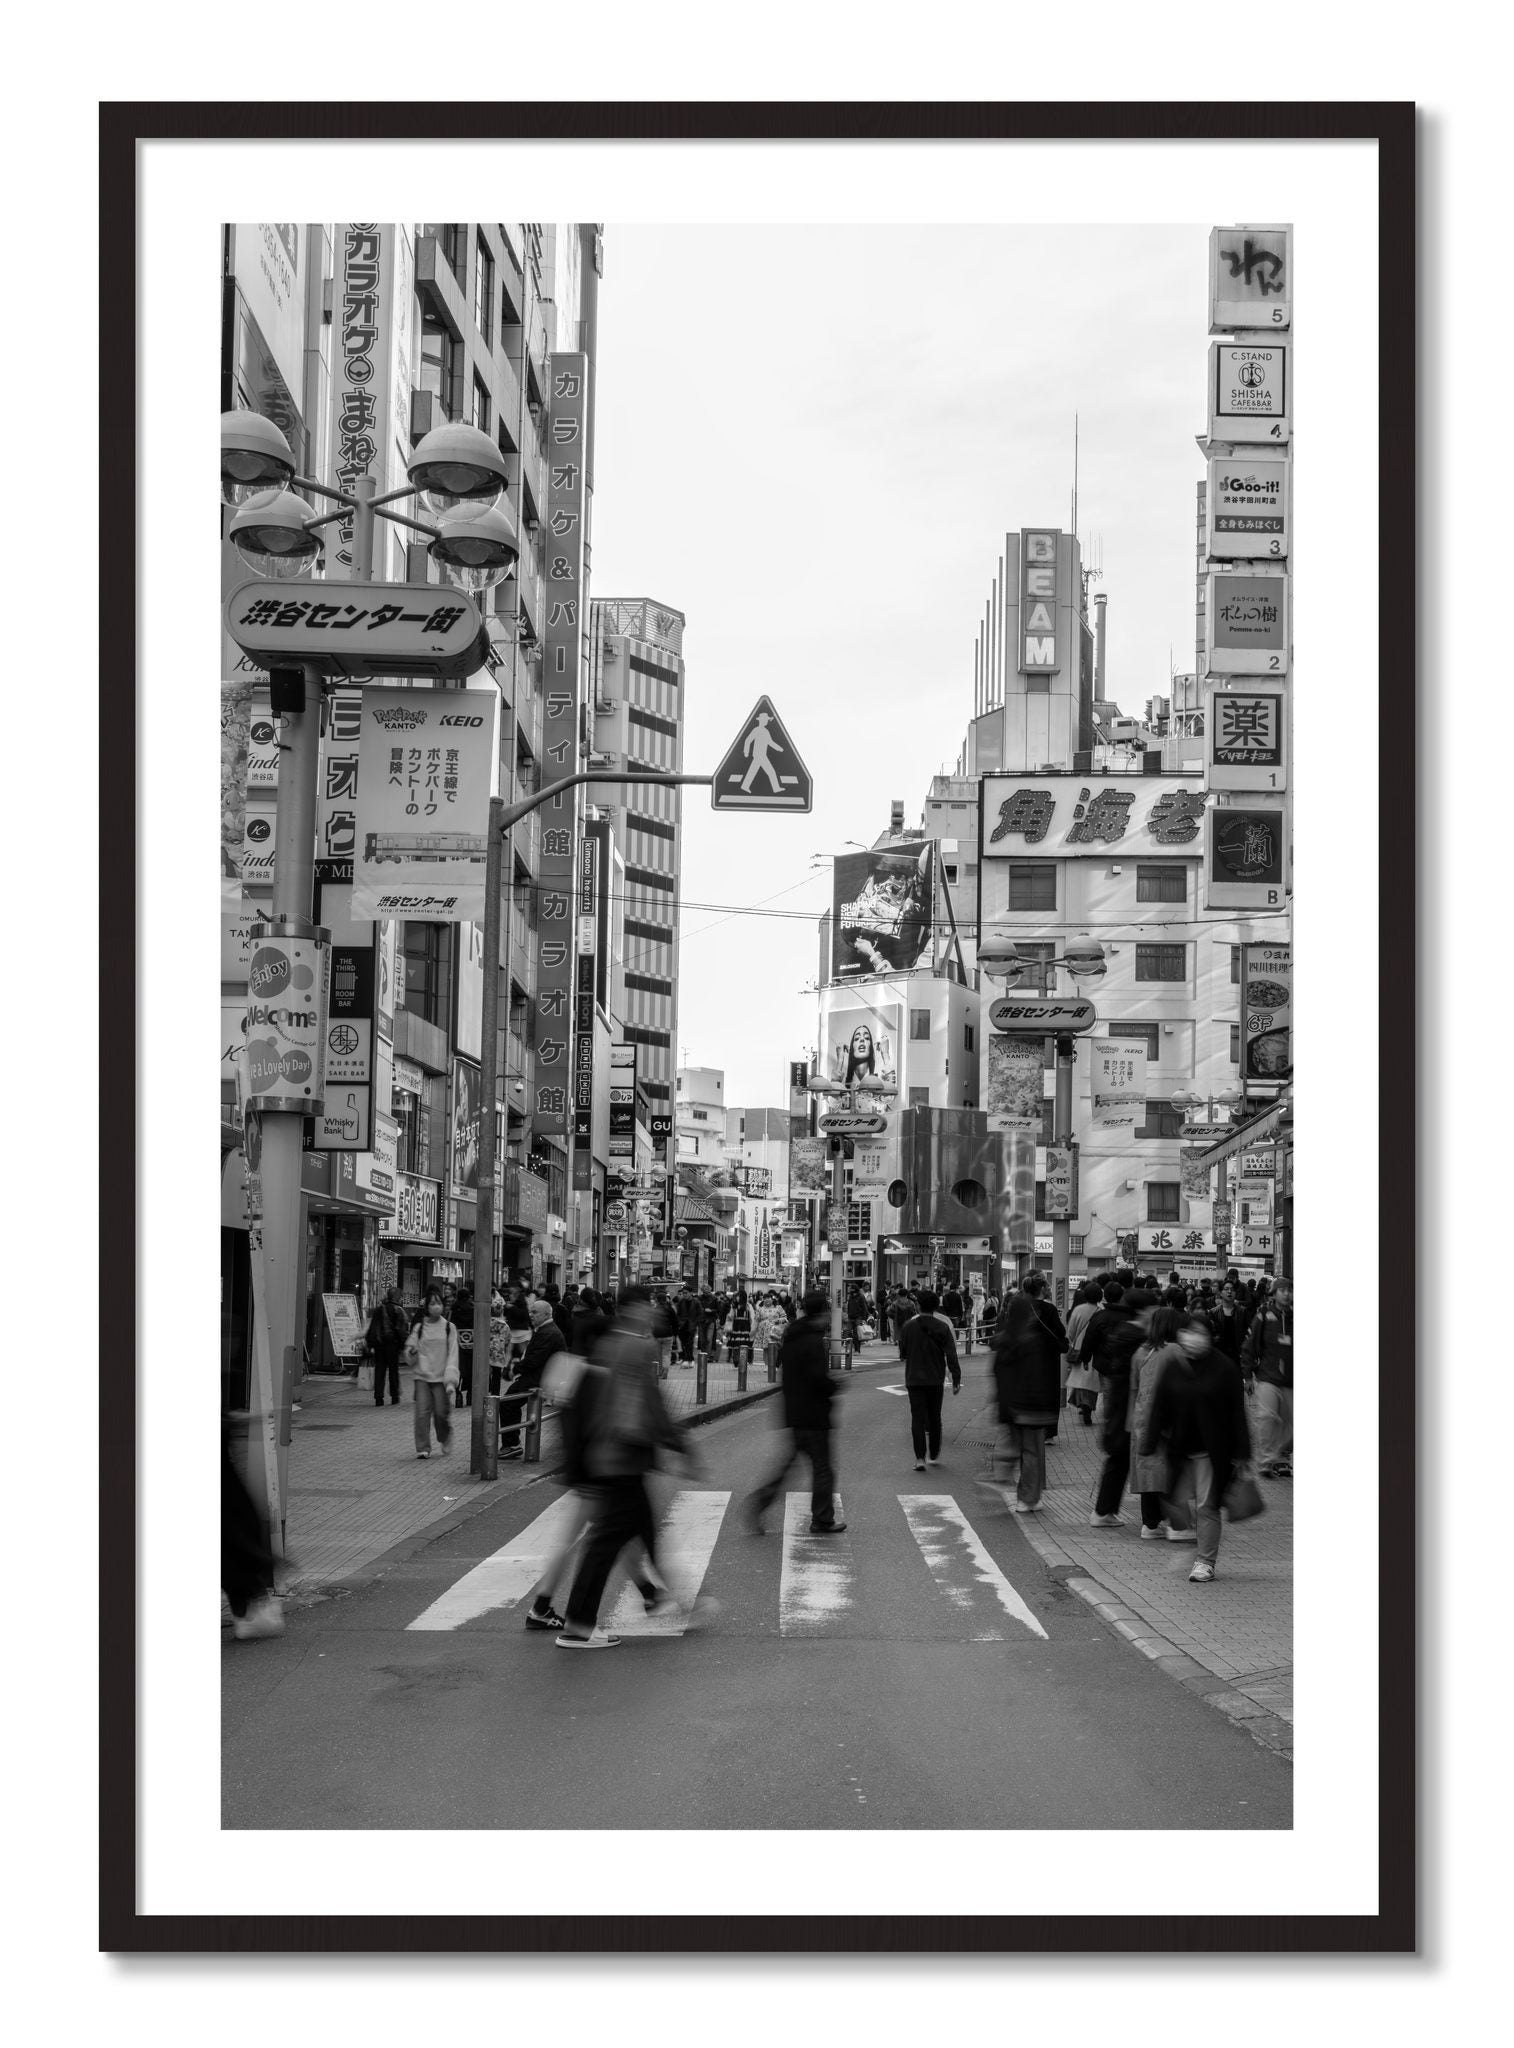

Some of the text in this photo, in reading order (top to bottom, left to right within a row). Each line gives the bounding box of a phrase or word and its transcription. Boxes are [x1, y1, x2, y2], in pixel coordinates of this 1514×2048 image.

[344, 229, 382, 356] カラオケ
[1271, 308, 1283, 323] 5
[1231, 352, 1273, 361] C.STAND
[1231, 389, 1272, 399] SHISHA
[1231, 399, 1272, 407] CAFE&BAR
[1271, 423, 1282, 438] 4
[1230, 478, 1280, 493] Goo-it!
[1219, 519, 1281, 530] 全身もみほぐし
[1269, 540, 1281, 555] 3
[1027, 533, 1056, 666] BEAM
[239, 599, 466, 633] 渋谷センター街
[544, 371, 580, 861] カラオケ&パーティー館
[1219, 605, 1279, 622] ポムの樹
[1269, 656, 1281, 670] 2
[384, 721, 416, 730] KANTO
[439, 715, 484, 727] KEIO
[1222, 700, 1269, 747] 薬
[1217, 749, 1274, 763] マツモトキヨシ
[388, 747, 403, 787] 冒険へ
[251, 772, 275, 781] 渋谷店
[405, 746, 421, 815] カントーの
[424, 746, 441, 816] ポケパーク
[443, 748, 460, 803] 京王線で
[1268, 772, 1277, 788] 1
[990, 788, 1206, 844] 角海老
[584, 842, 593, 876] kimono
[247, 870, 271, 879] 渋谷店
[377, 896, 459, 908] 渋谷センター街
[584, 879, 592, 911] hearts
[1267, 889, 1279, 907] B
[251, 958, 288, 991] Enjoy
[537, 892, 571, 1116] カラオケ館
[247, 1004, 318, 1028] Welcome
[996, 1006, 1091, 1019] 渋谷センター街
[1247, 1014, 1274, 1033] 6F
[263, 1057, 290, 1075] Lovely
[292, 1059, 310, 1072] Day!
[325, 1118, 354, 1128] Whisky
[653, 1121, 671, 1131] GU
[324, 1127, 342, 1136] Bank
